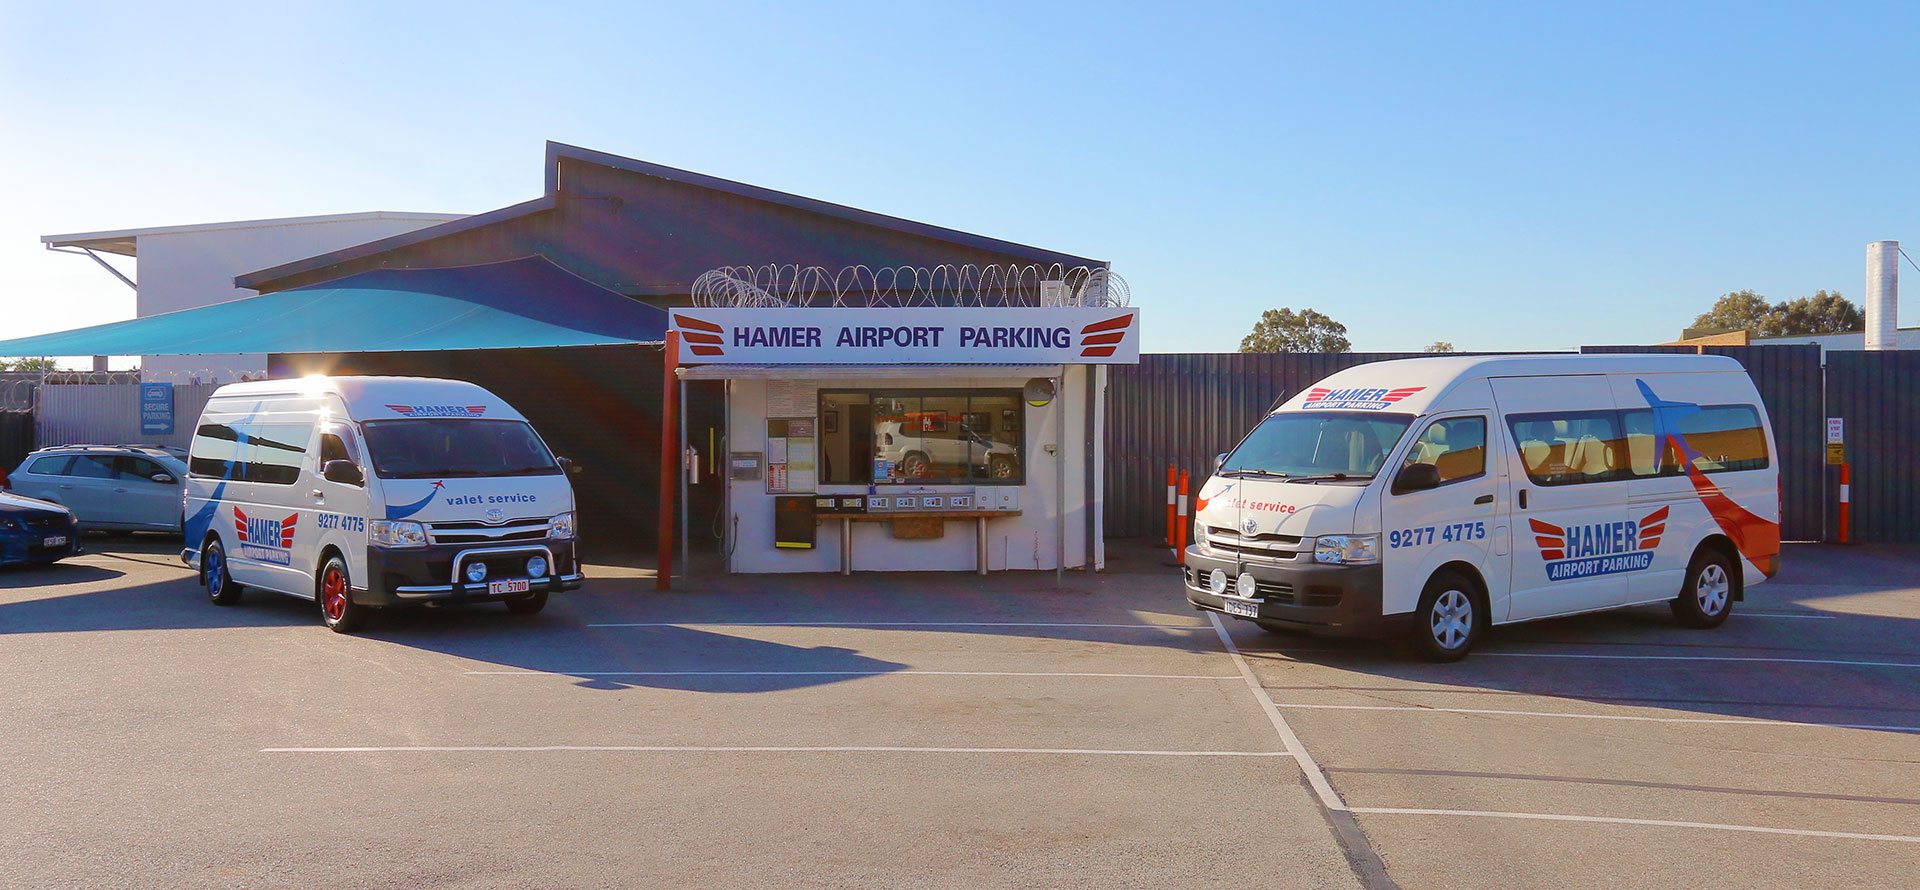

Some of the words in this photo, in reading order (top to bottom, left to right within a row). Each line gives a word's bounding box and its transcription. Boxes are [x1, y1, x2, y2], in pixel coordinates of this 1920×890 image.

[733, 326, 822, 348] HAMER
[836, 326, 944, 348] AIRPORT
[959, 326, 1071, 348] PARKING
[1322, 388, 1389, 401] HAMER
[143, 403, 169, 411] SECURE
[413, 405, 467, 414] HAMER
[1304, 401, 1343, 409] AIRPORT
[1343, 402, 1386, 410] PARKING
[143, 411, 171, 420] PARKING
[446, 495, 484, 506] valet
[488, 492, 537, 504] service
[1249, 500, 1296, 514] service
[318, 513, 339, 529] 9277
[341, 515, 364, 533] 4775
[247, 517, 281, 548] HAMER
[1389, 526, 1435, 549] 9277
[1442, 521, 1486, 543] 4775
[1566, 520, 1638, 559] HAMER
[1551, 559, 1599, 580] AIRPORT
[1601, 551, 1649, 572] PARKING
[492, 583, 503, 593] TC
[507, 581, 527, 592] 5700
